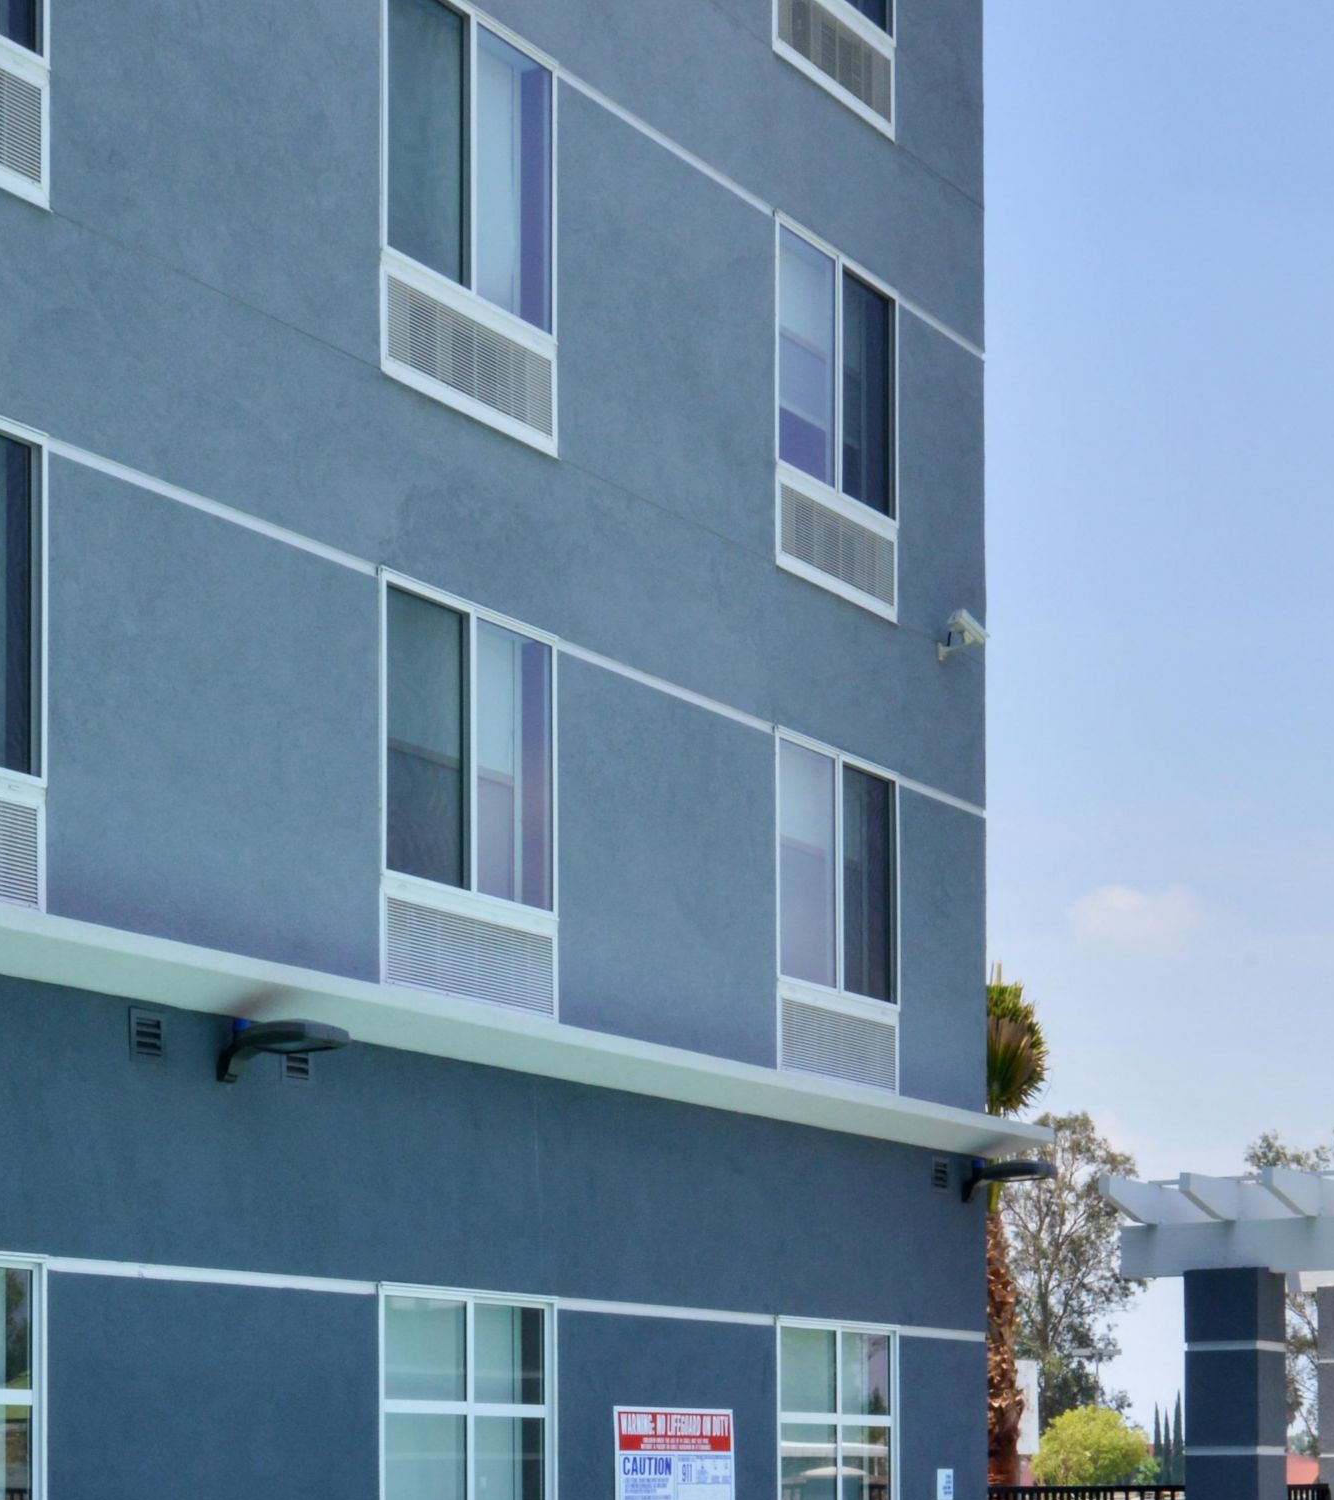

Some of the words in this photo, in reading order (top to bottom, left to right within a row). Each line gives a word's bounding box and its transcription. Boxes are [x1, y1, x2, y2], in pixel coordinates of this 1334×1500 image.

[656, 1414, 666, 1435] NO
[667, 1414, 702, 1436] LIFEGUARD
[712, 1415, 729, 1437] DUTY
[622, 1456, 673, 1476] CAUTION
[681, 1464, 693, 1482] 911
